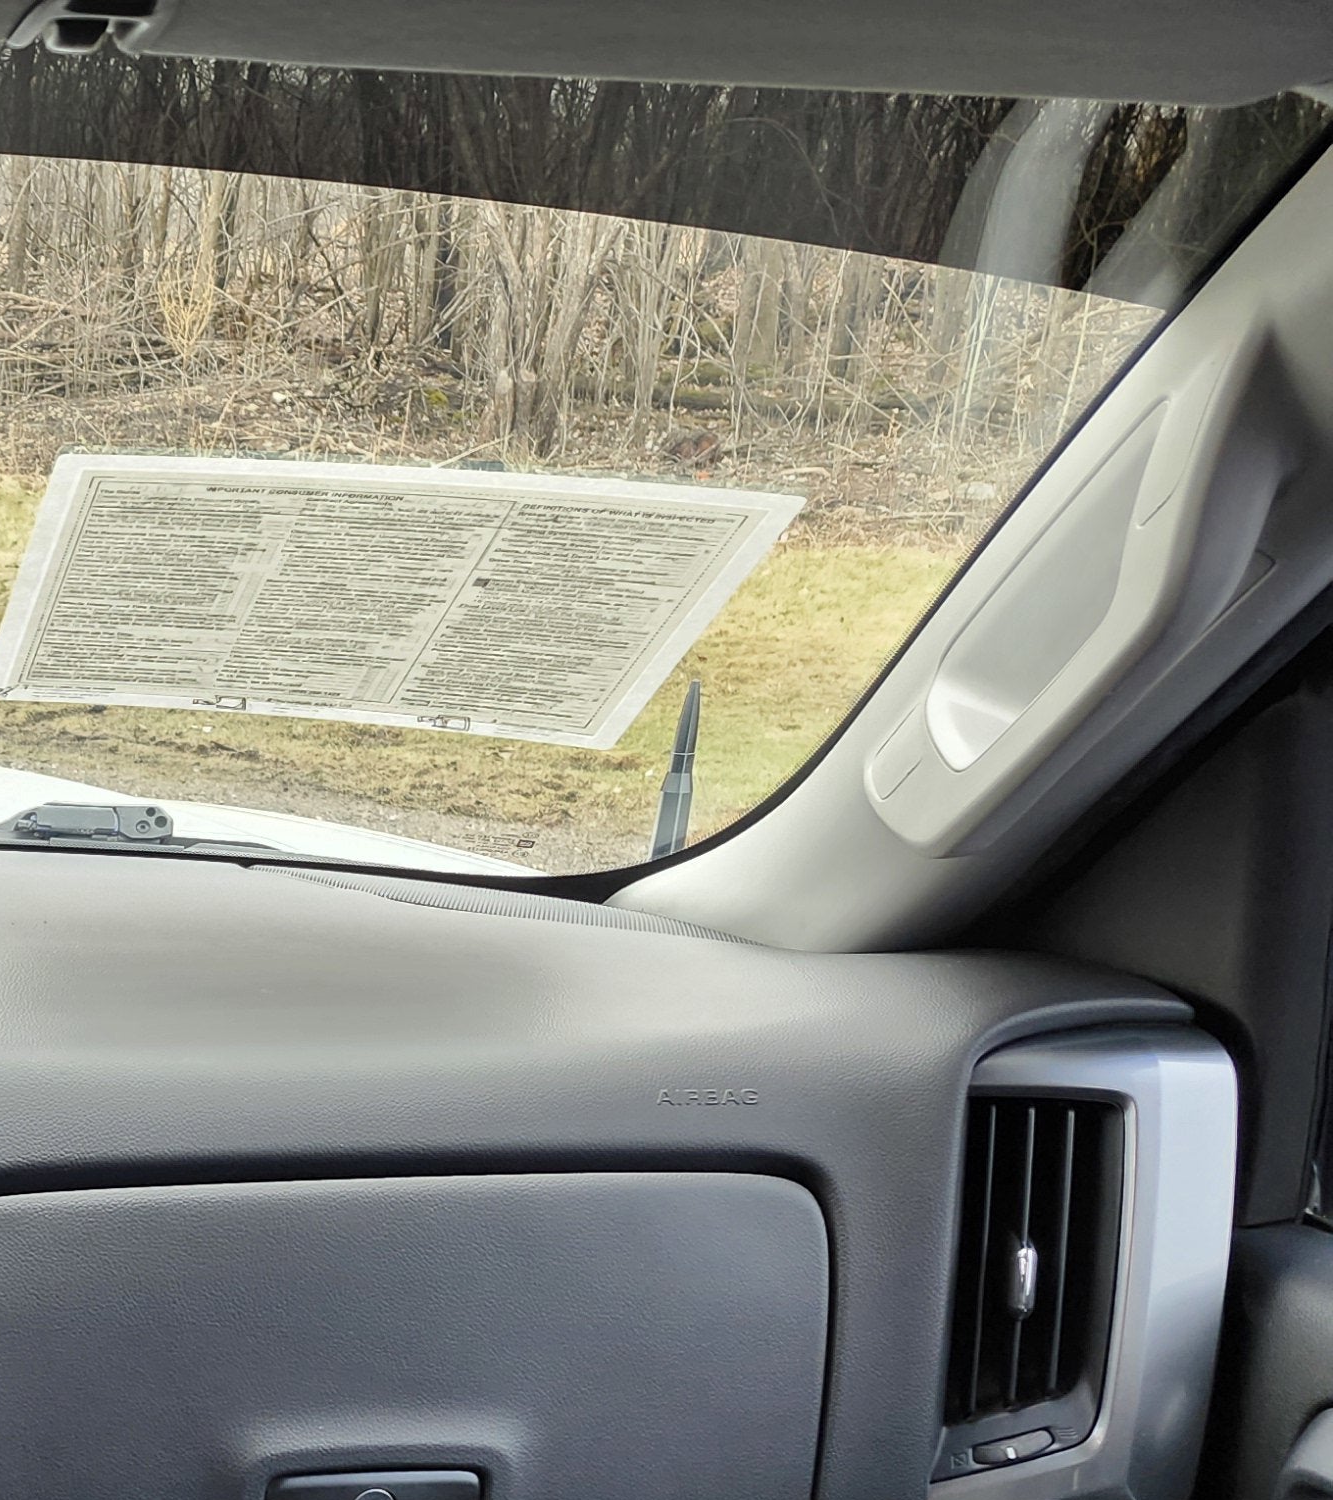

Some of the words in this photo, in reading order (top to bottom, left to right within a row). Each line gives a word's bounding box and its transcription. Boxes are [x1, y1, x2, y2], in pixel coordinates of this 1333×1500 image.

[268, 488, 329, 497] CONSUMER
[331, 492, 405, 502] INFORMATION
[520, 503, 588, 514] DEFINITIONS
[609, 510, 640, 518] WHAT
[656, 1087, 760, 1107] AIRBAG
